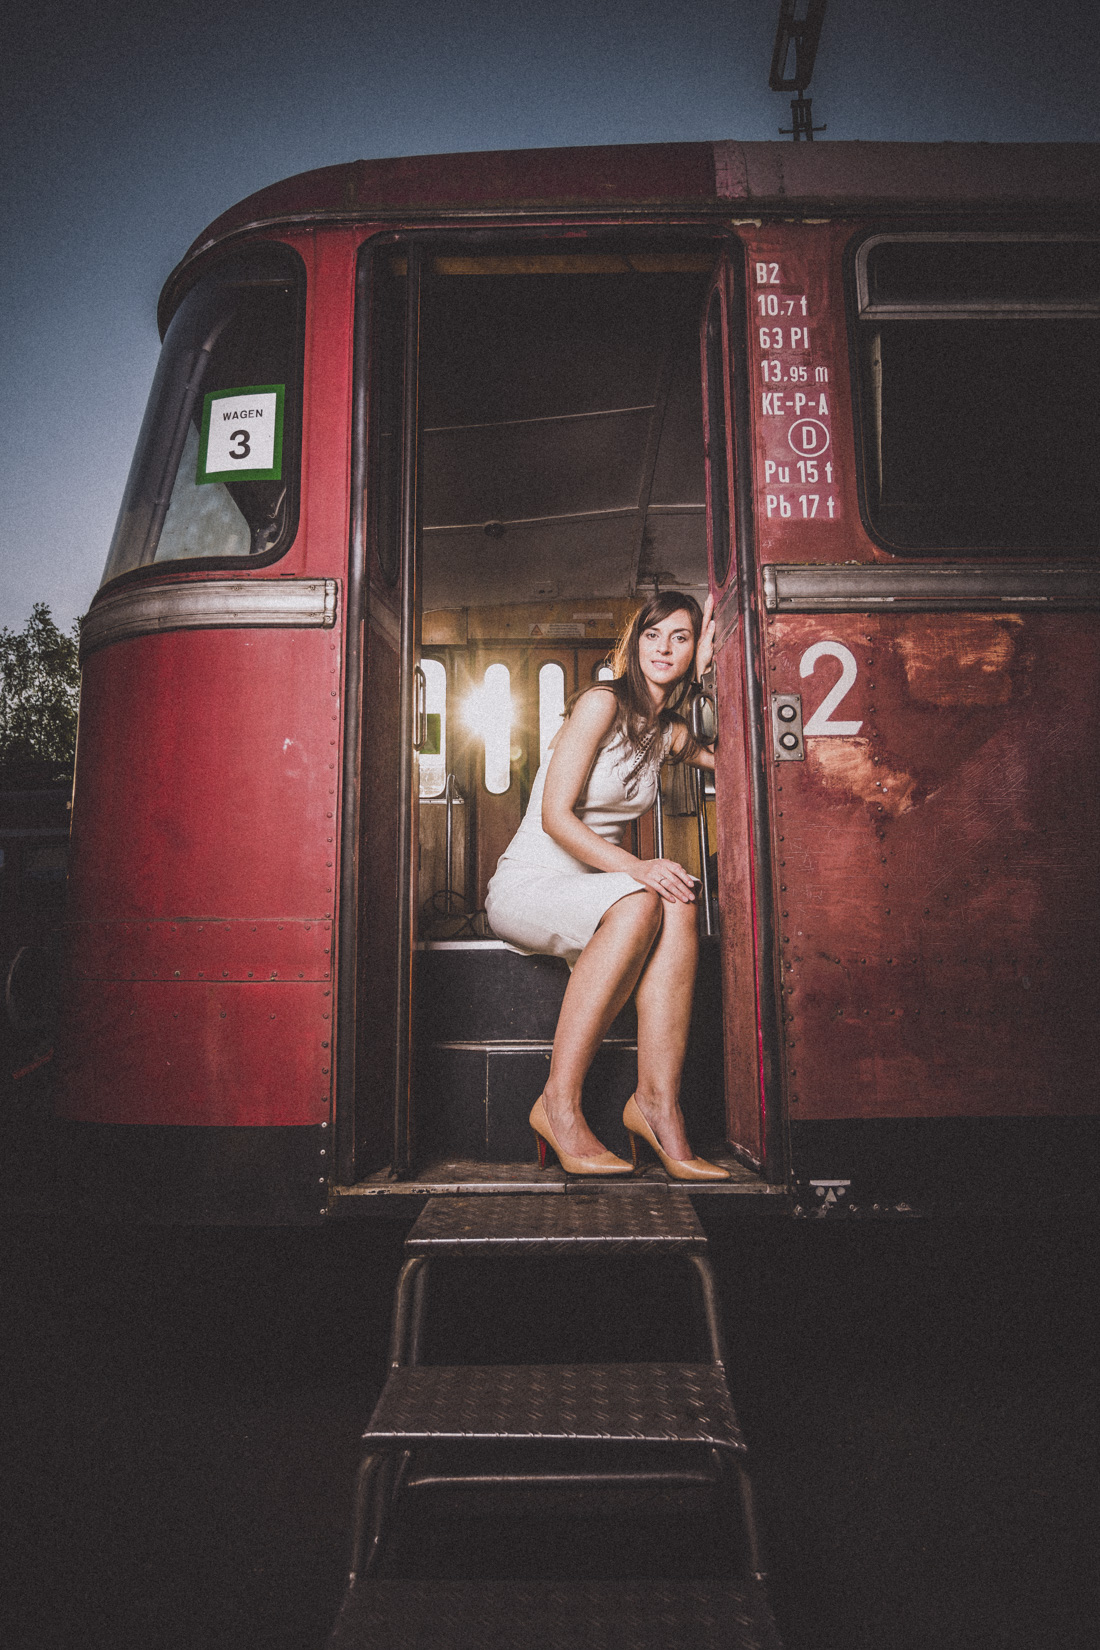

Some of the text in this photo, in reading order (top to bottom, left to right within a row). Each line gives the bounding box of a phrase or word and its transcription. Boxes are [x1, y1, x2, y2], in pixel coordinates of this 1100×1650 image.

[756, 262, 780, 284] B2
[800, 295, 808, 316] t
[759, 327, 783, 349] 63
[814, 366, 829, 382] m
[222, 408, 263, 421] WAGEN
[762, 392, 829, 415] KE-P-A
[228, 429, 251, 460] 3
[802, 426, 817, 449] D
[764, 460, 833, 483] Pu 15 t
[766, 494, 835, 518] Pb 17 t
[799, 640, 863, 736] 2
